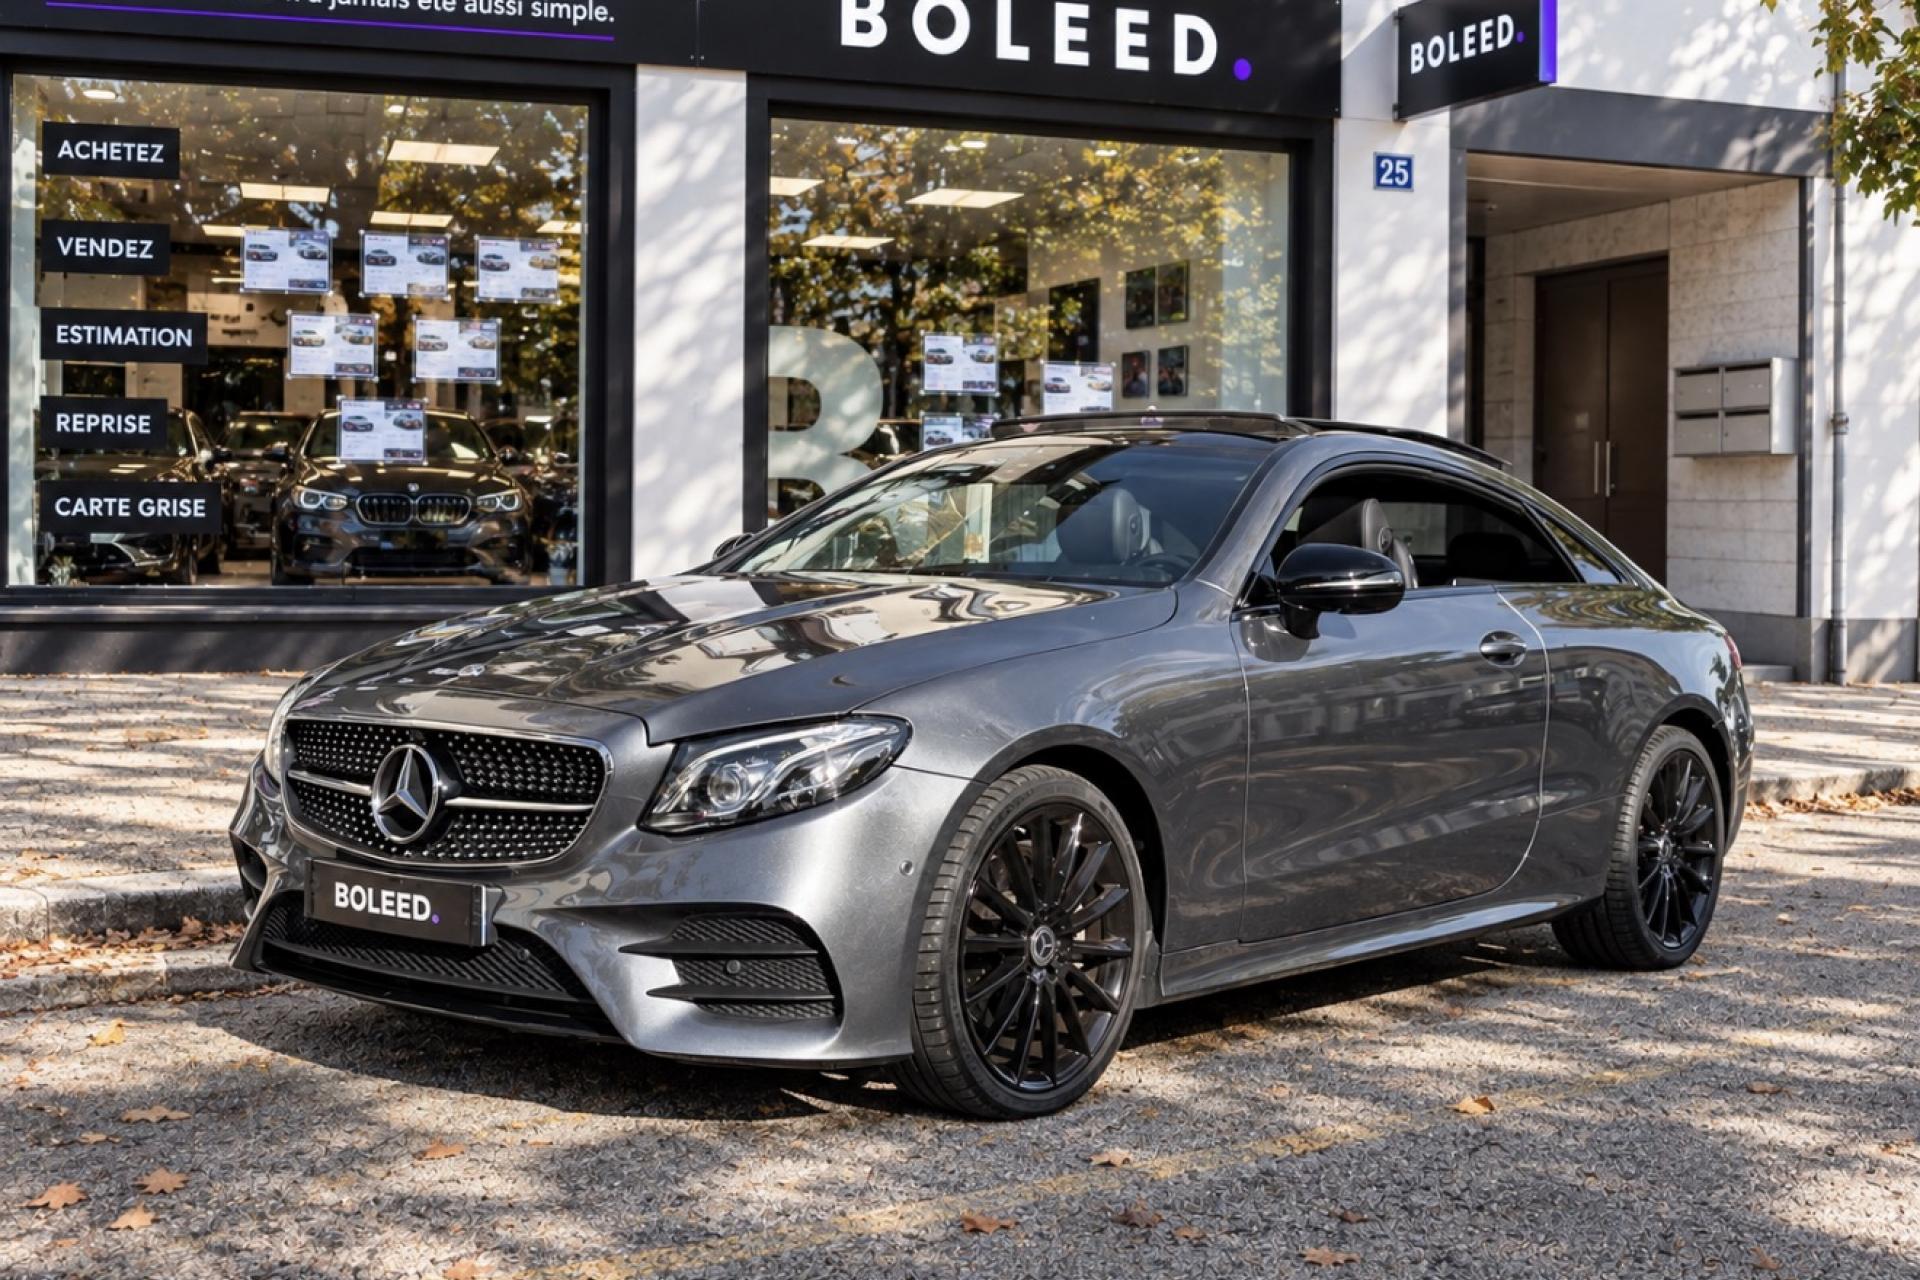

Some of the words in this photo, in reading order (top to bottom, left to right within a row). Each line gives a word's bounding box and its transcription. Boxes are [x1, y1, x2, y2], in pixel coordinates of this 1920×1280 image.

[328, 0, 410, 10] jas
[464, 0, 523, 16] aussi
[530, 0, 615, 26] simple.
[57, 140, 164, 163] ACHETEZ
[1379, 159, 1409, 186] 25
[56, 236, 154, 259] VENDEZ
[56, 325, 193, 347] ESTIMATION
[56, 413, 151, 434] REPRISE
[55, 497, 131, 517] CARTE
[138, 498, 206, 518] GRISE
